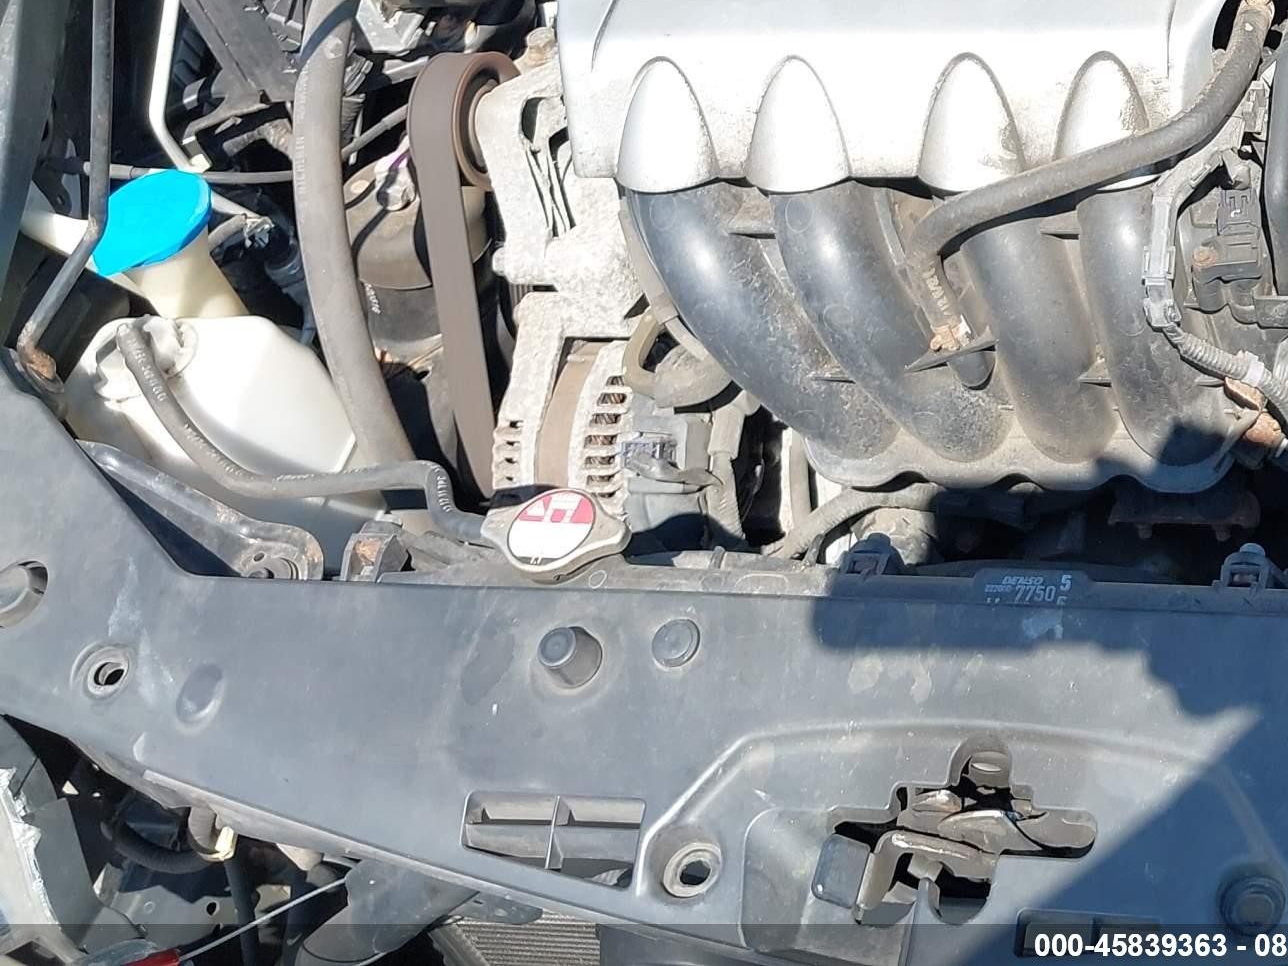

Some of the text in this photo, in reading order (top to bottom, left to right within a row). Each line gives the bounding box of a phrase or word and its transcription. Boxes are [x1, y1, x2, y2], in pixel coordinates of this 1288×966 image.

[1002, 576, 1044, 585] DENSO
[1060, 574, 1072, 592] 5
[1014, 585, 1057, 604] 7750
